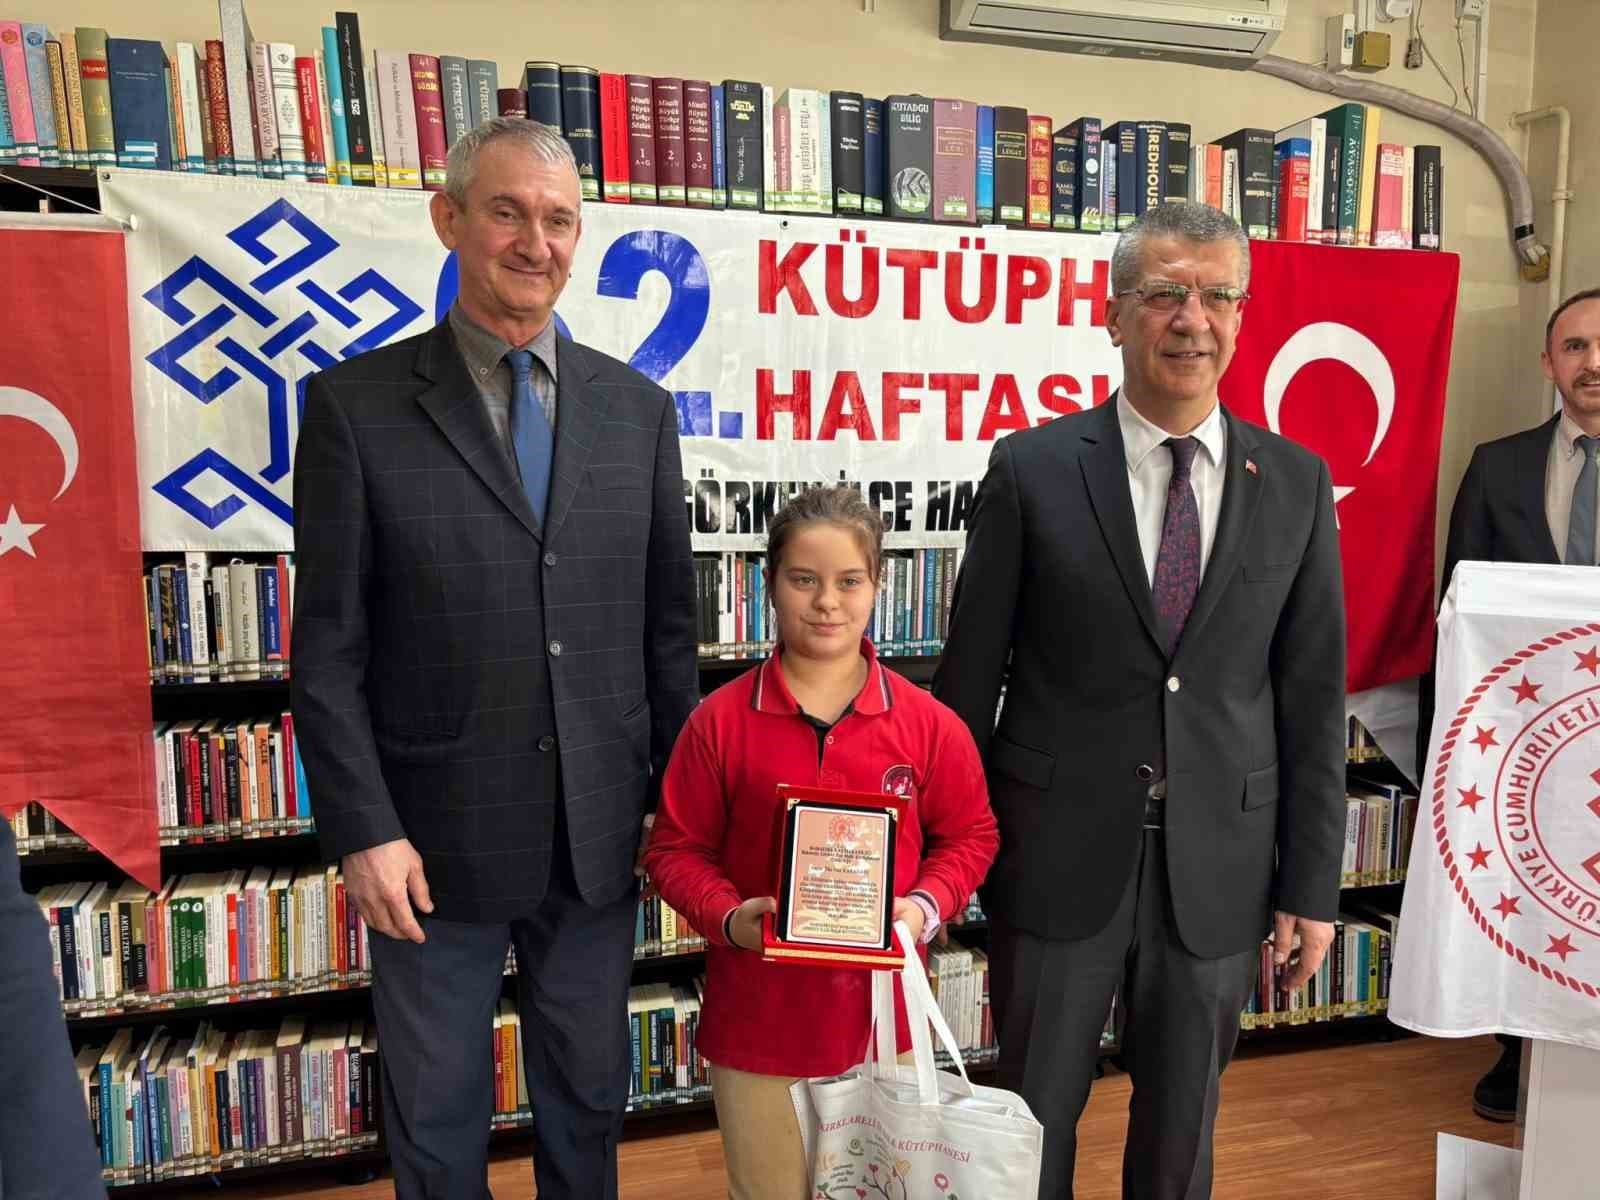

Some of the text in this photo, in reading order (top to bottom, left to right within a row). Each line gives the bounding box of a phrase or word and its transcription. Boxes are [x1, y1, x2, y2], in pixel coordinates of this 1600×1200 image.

[757, 229, 1111, 327] KÜTÜPH
[925, 481, 981, 532] HA
[1506, 697, 1599, 924] ÜRKİYE CUMHURİYETİ
